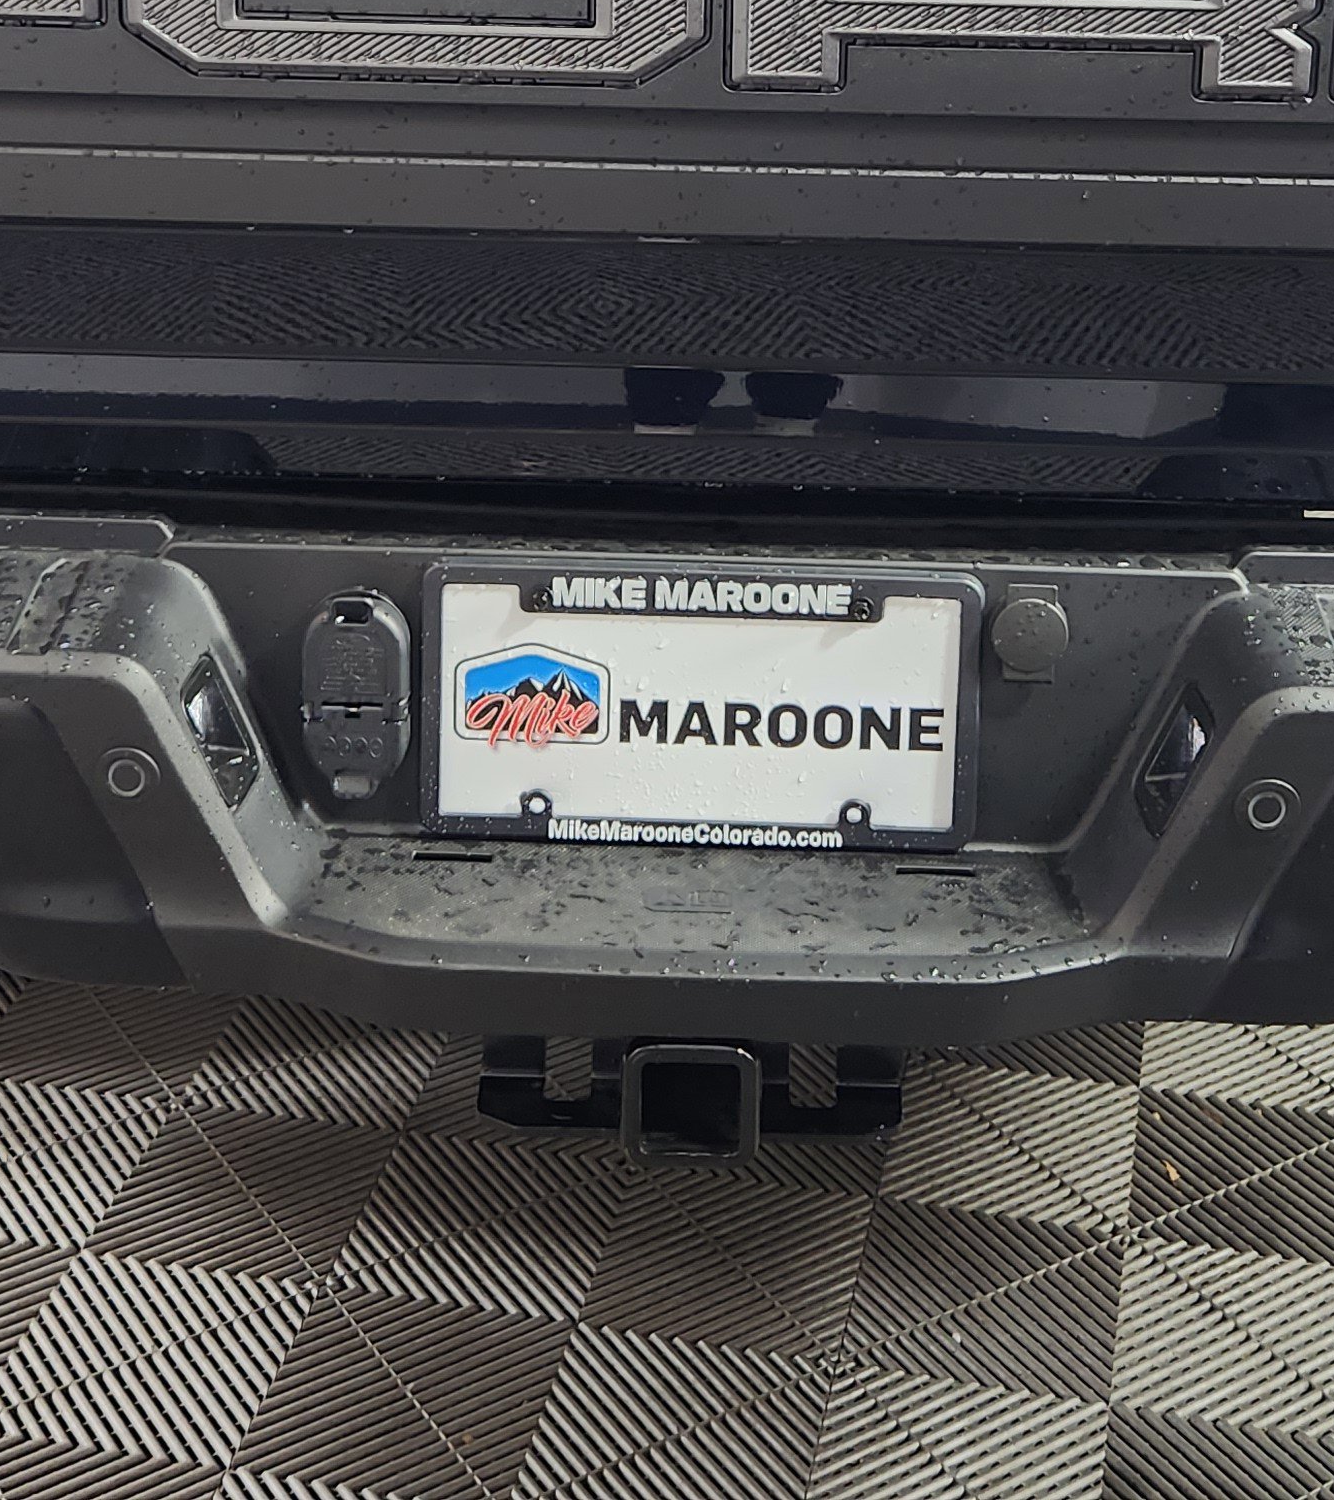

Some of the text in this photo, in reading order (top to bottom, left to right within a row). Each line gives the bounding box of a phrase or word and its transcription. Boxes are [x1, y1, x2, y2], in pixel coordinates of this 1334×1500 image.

[551, 576, 854, 616] MIKE MAROONE
[465, 688, 945, 752] Mike MAROONE
[547, 818, 844, 849] MikeMarooneColorado.com
